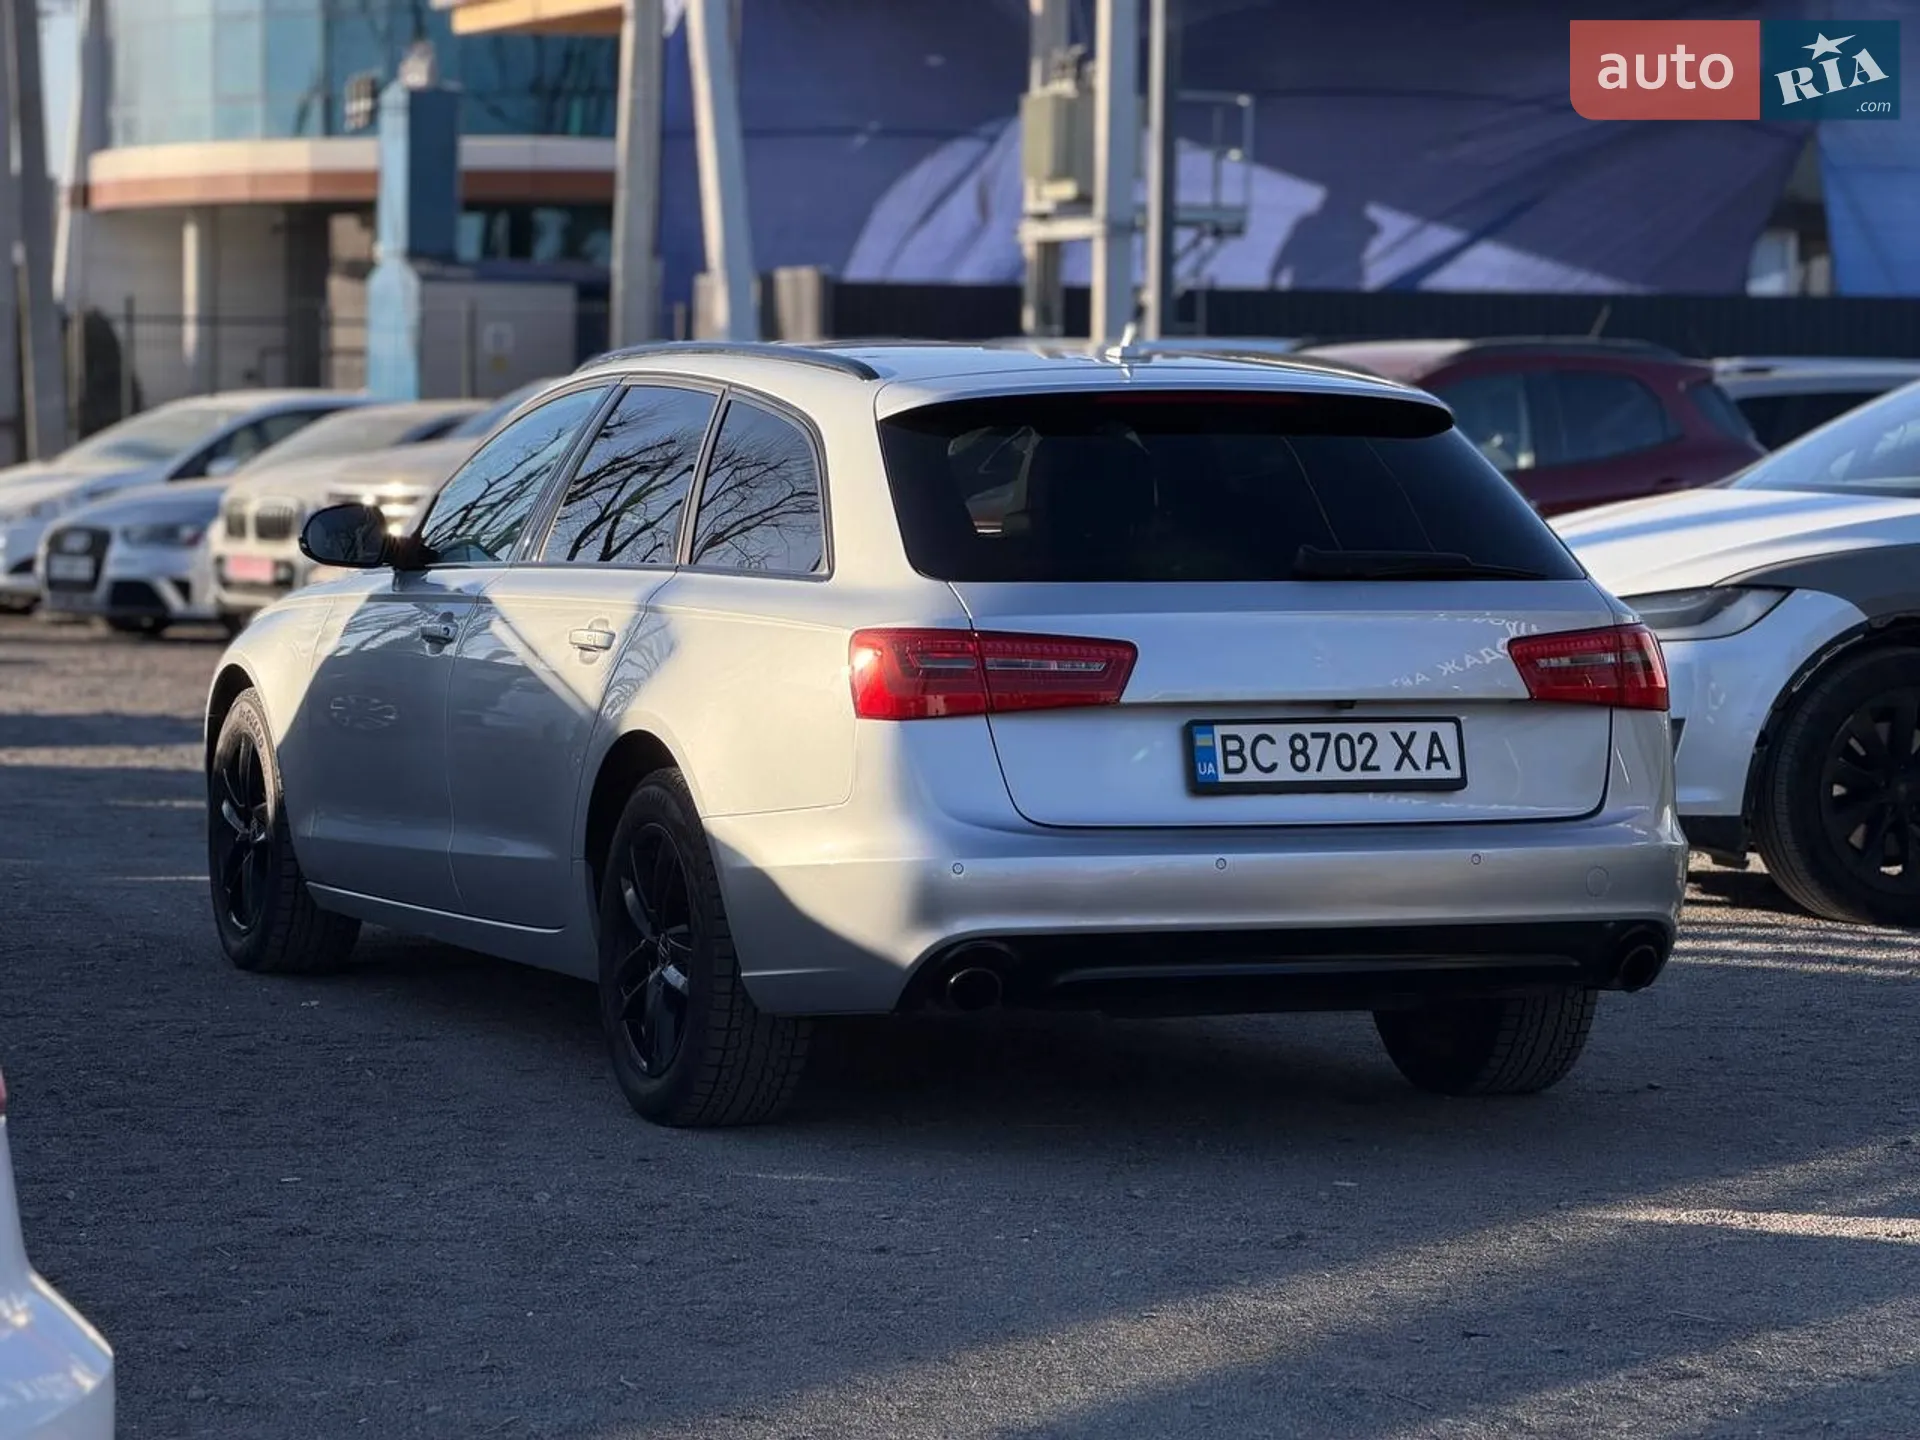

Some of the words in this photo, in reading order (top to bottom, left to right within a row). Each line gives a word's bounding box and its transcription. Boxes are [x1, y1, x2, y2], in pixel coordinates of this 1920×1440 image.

[1220, 734, 1279, 775] BC
[1288, 732, 1381, 773] 8702
[1389, 730, 1452, 772] XA
[1198, 762, 1216, 776] UA
